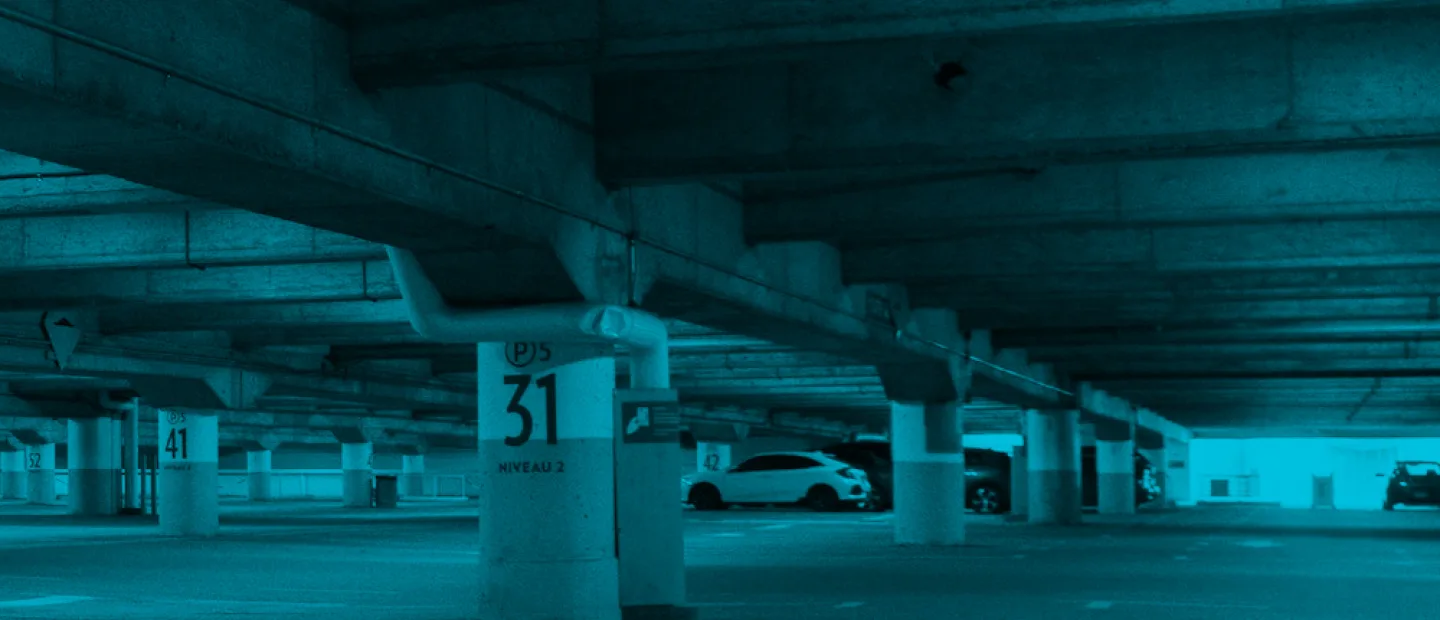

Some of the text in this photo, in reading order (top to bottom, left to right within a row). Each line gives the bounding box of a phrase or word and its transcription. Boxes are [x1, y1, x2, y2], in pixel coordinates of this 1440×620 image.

[503, 373, 557, 446] 31
[165, 428, 187, 459] 41
[499, 461, 565, 473] NIVEAU 2
[703, 454, 720, 471] 42
